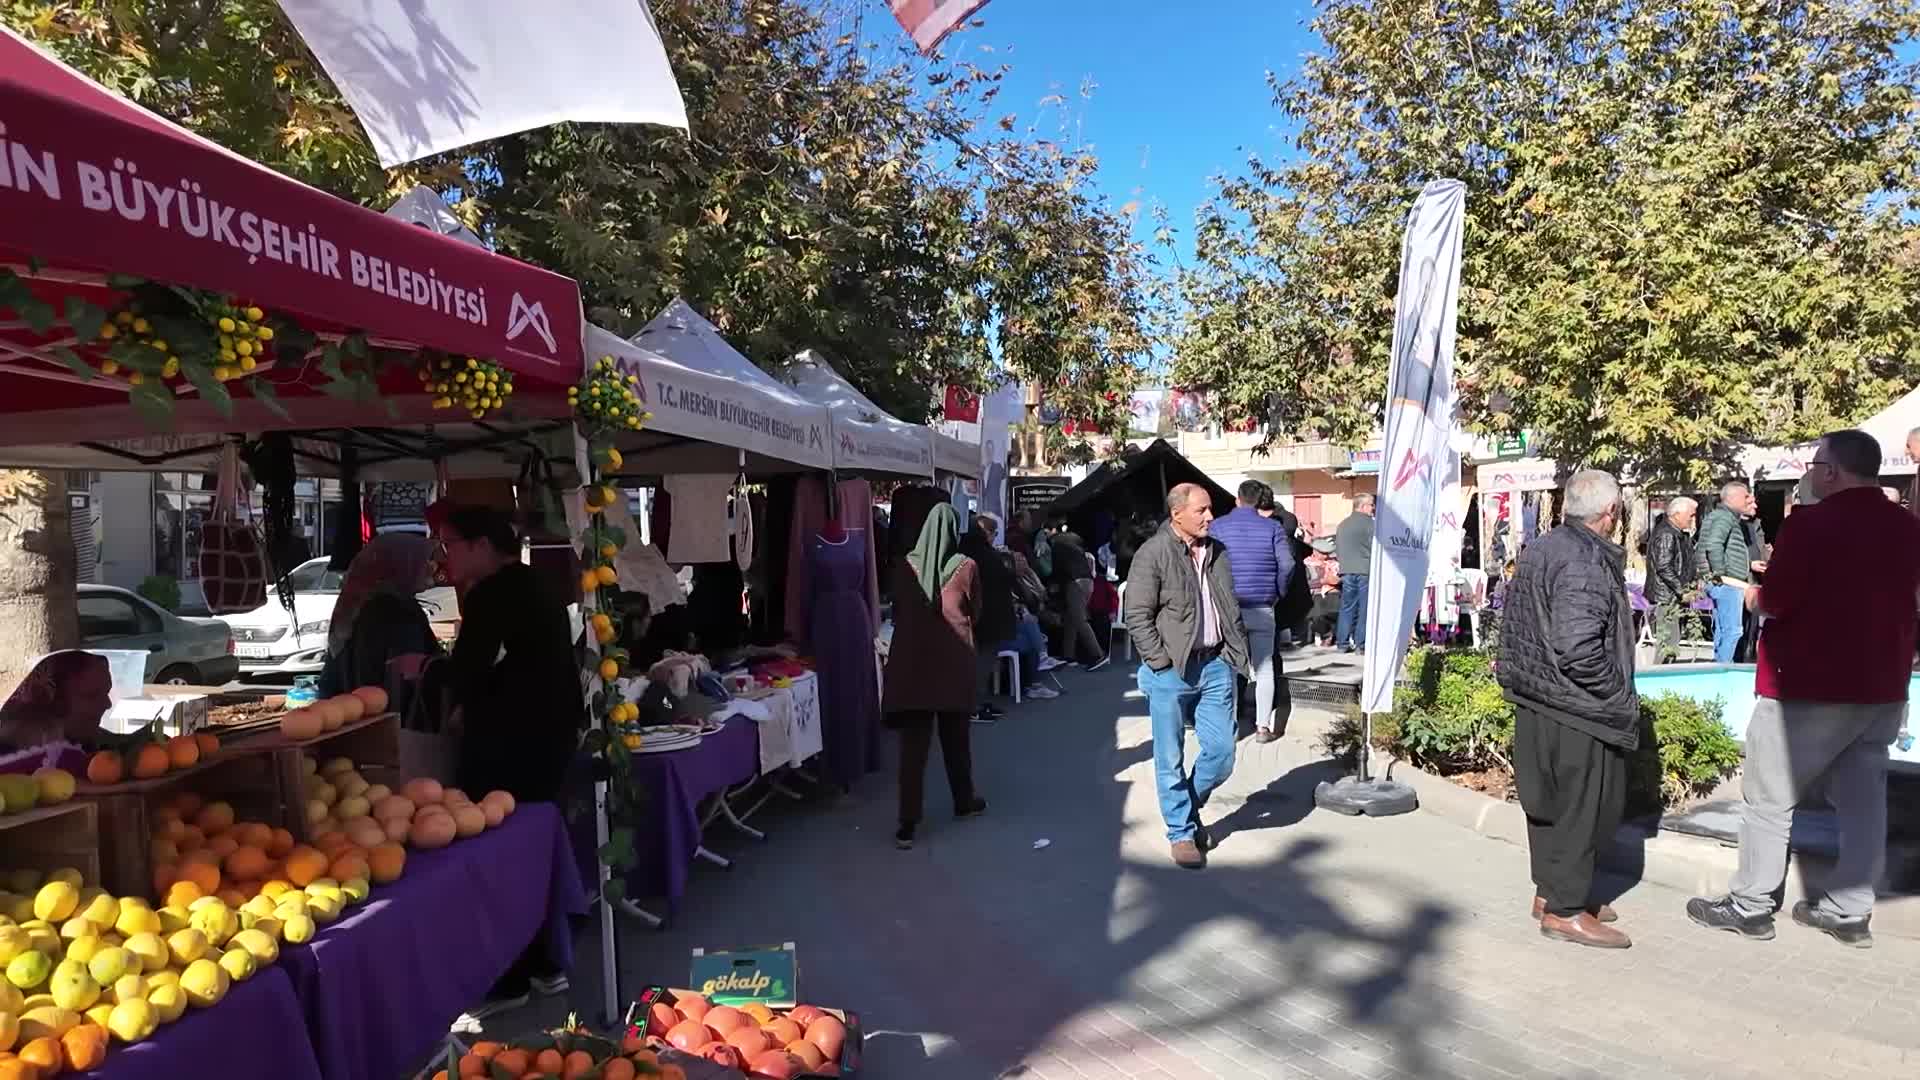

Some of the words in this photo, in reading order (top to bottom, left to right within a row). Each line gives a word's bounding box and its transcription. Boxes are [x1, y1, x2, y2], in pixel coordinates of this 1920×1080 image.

[77, 157, 342, 280] BÜYÜKŞEHİR
[350, 249, 488, 327] BELEDİYESİ
[657, 382, 677, 409] T.C.
[679, 389, 718, 419] MERSİN
[701, 969, 772, 998] gökalp
